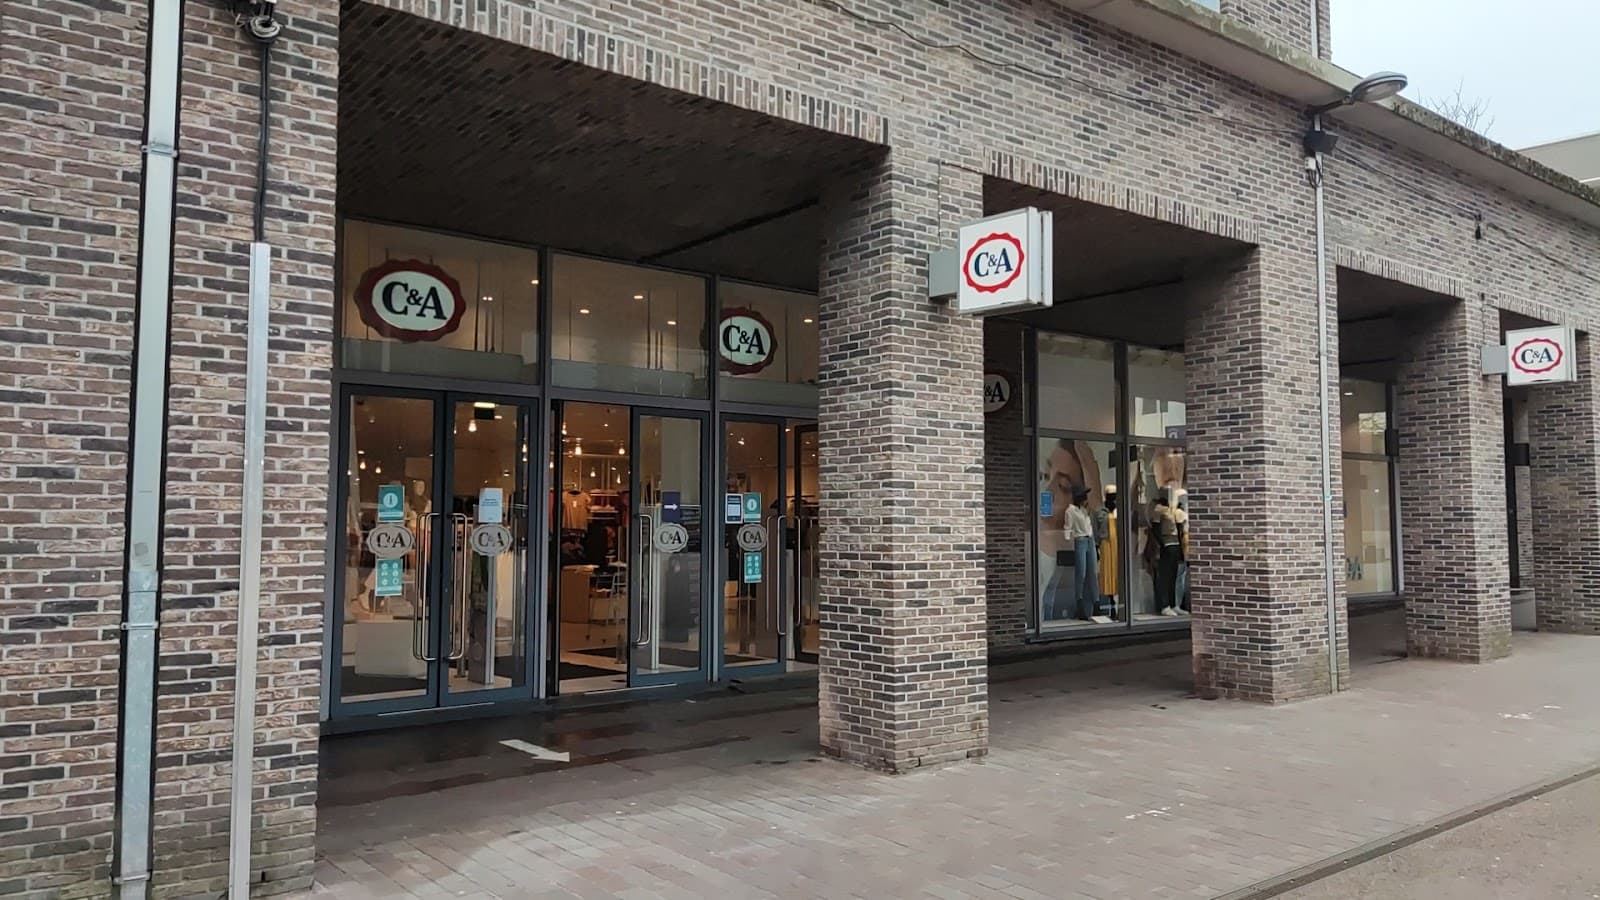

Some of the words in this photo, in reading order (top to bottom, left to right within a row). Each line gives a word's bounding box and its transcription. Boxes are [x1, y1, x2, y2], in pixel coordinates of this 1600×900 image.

[974, 247, 1013, 277] C&A
[382, 281, 447, 320] C&A
[723, 325, 766, 355] C&A
[1521, 347, 1554, 364] C&A
[984, 381, 1006, 403] &A
[660, 530, 682, 545] C&A
[743, 529, 763, 544] C&A
